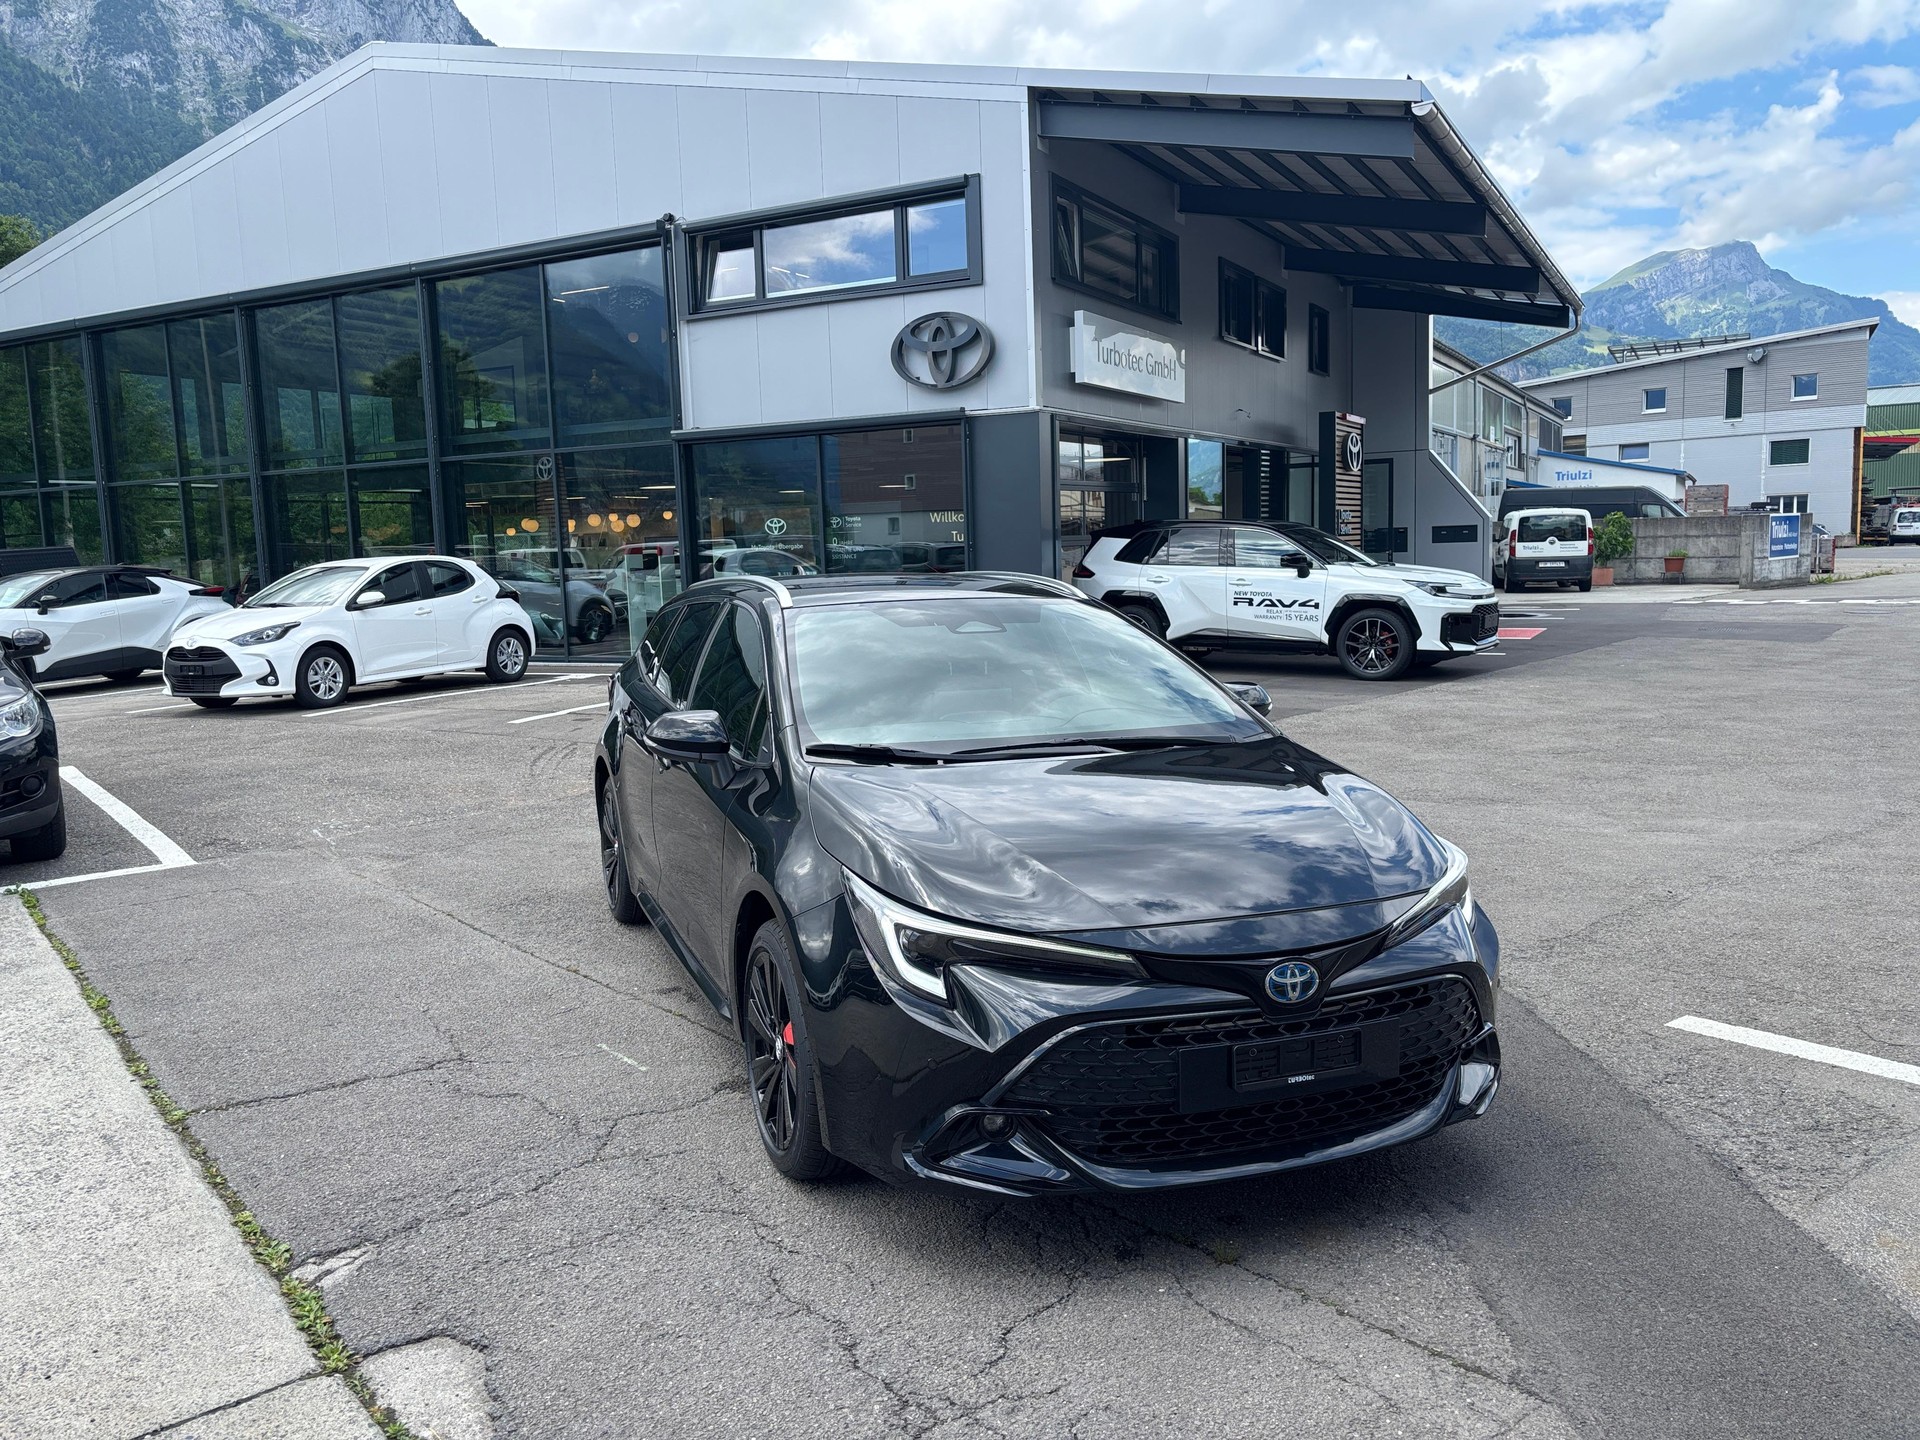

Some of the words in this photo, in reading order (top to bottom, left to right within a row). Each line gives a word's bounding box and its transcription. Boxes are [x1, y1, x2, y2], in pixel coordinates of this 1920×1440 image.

[1092, 338, 1143, 373] Turbotec
[1145, 352, 1176, 381] GmbH
[1555, 469, 1592, 481] Triulzi
[951, 531, 965, 542] Tu
[1233, 597, 1320, 609] RAV4
[1285, 613, 1293, 621] 15
[1294, 614, 1319, 622] YEARS
